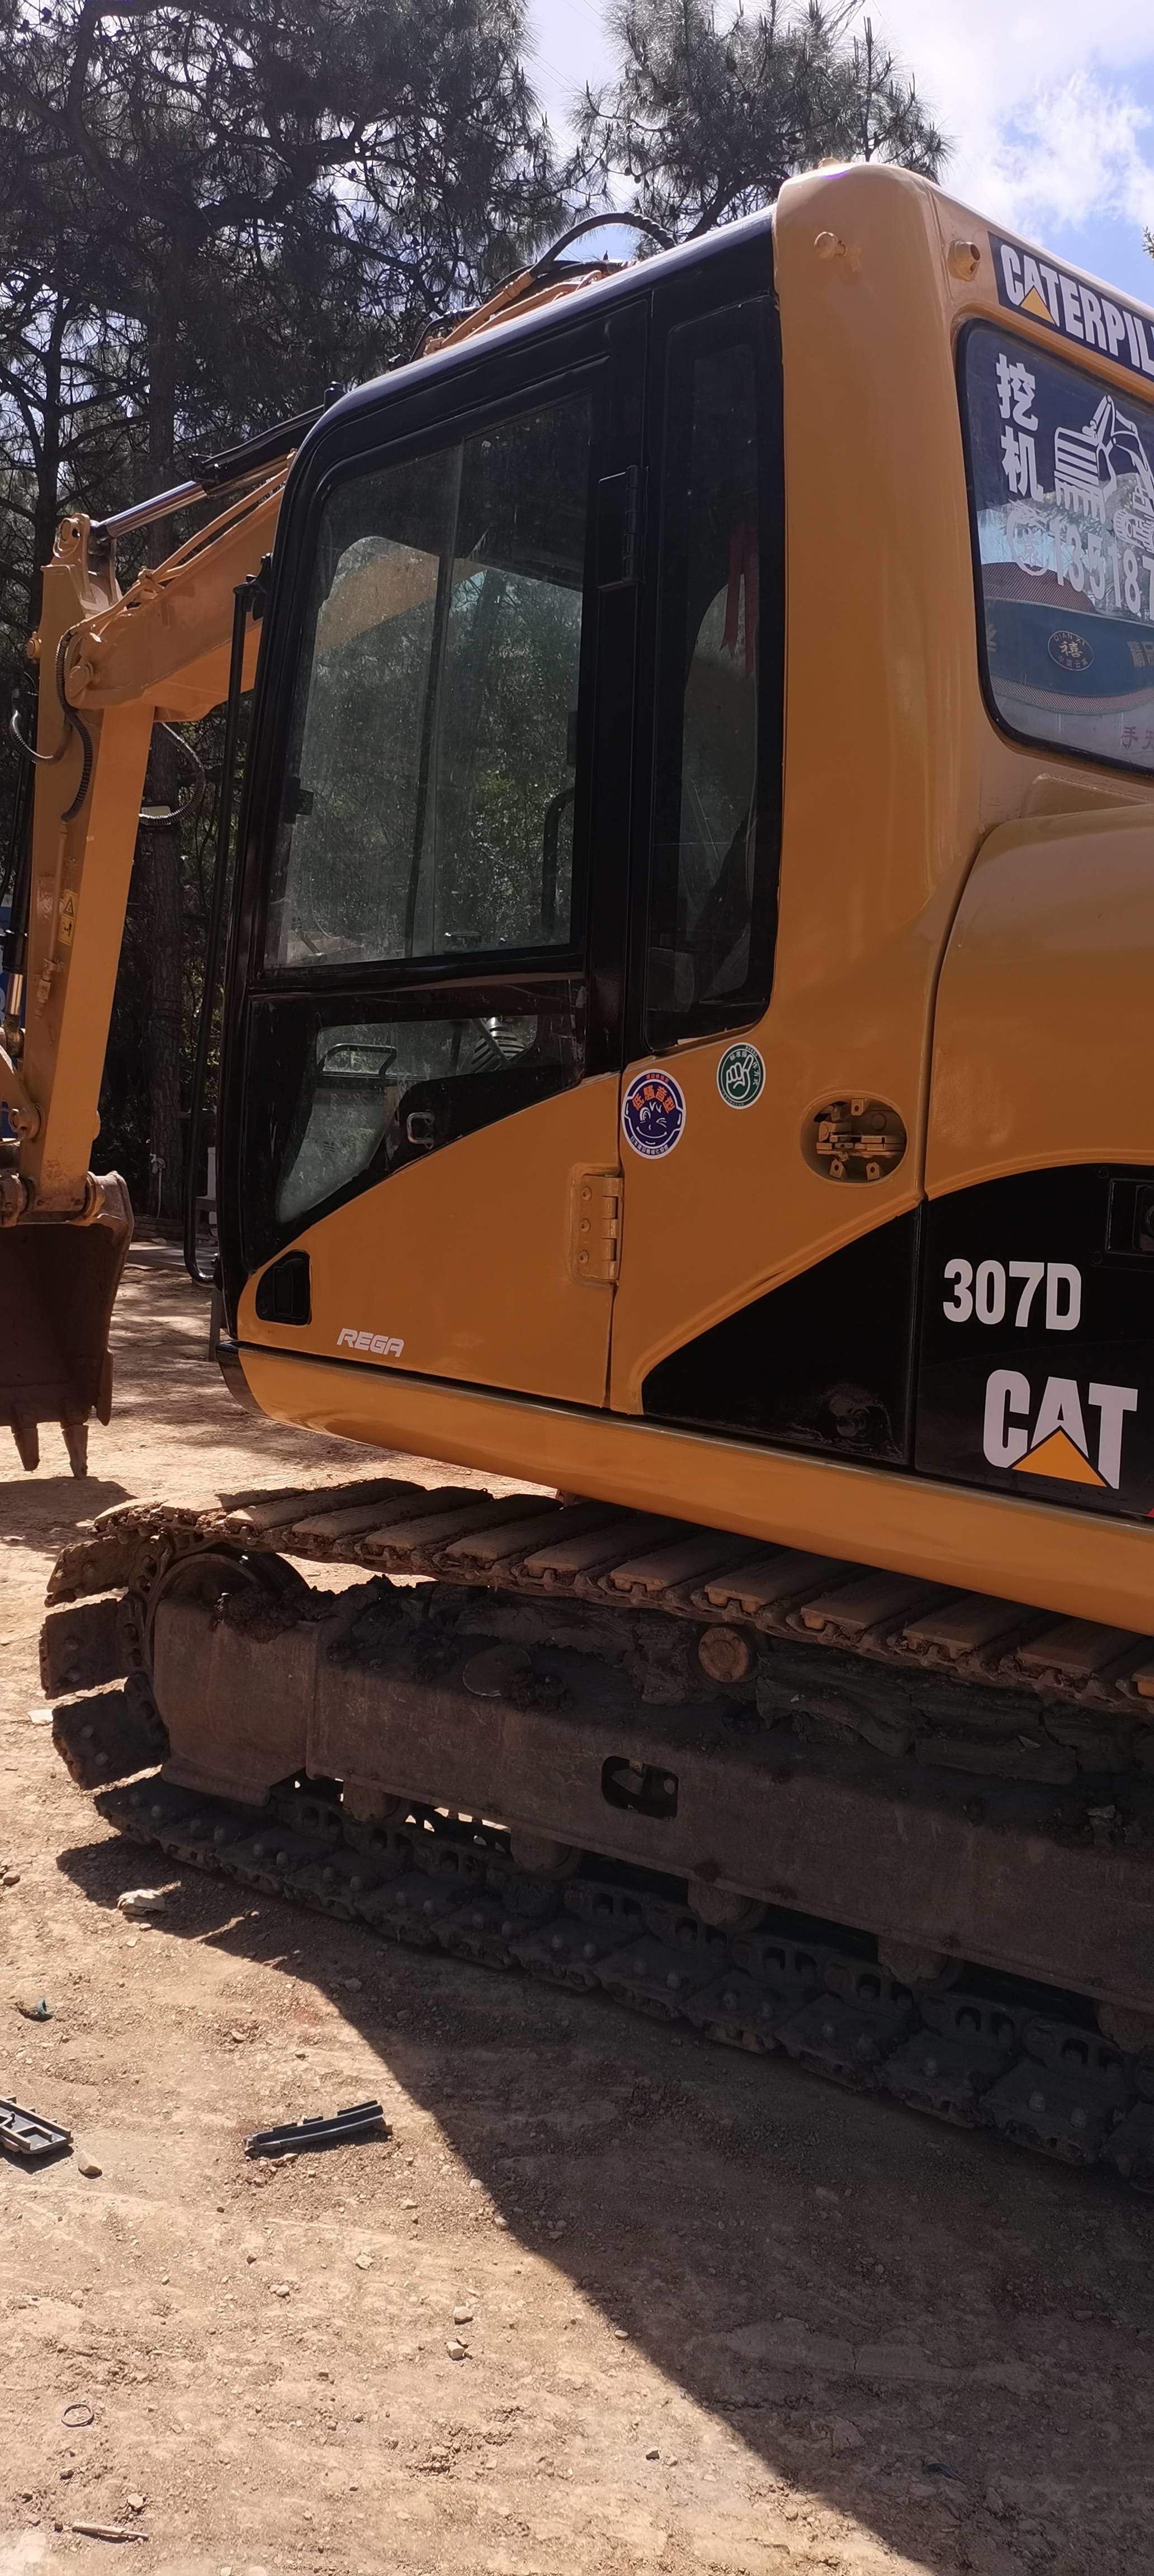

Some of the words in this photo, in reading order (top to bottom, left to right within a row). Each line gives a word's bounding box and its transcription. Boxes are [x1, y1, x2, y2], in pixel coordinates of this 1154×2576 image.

[1001, 245, 1154, 376] CATERPIL
[995, 353, 1044, 502] 挖机
[337, 1328, 405, 1358] REGA
[943, 1258, 1082, 1331] 307D
[983, 1369, 1138, 1490] CAT
